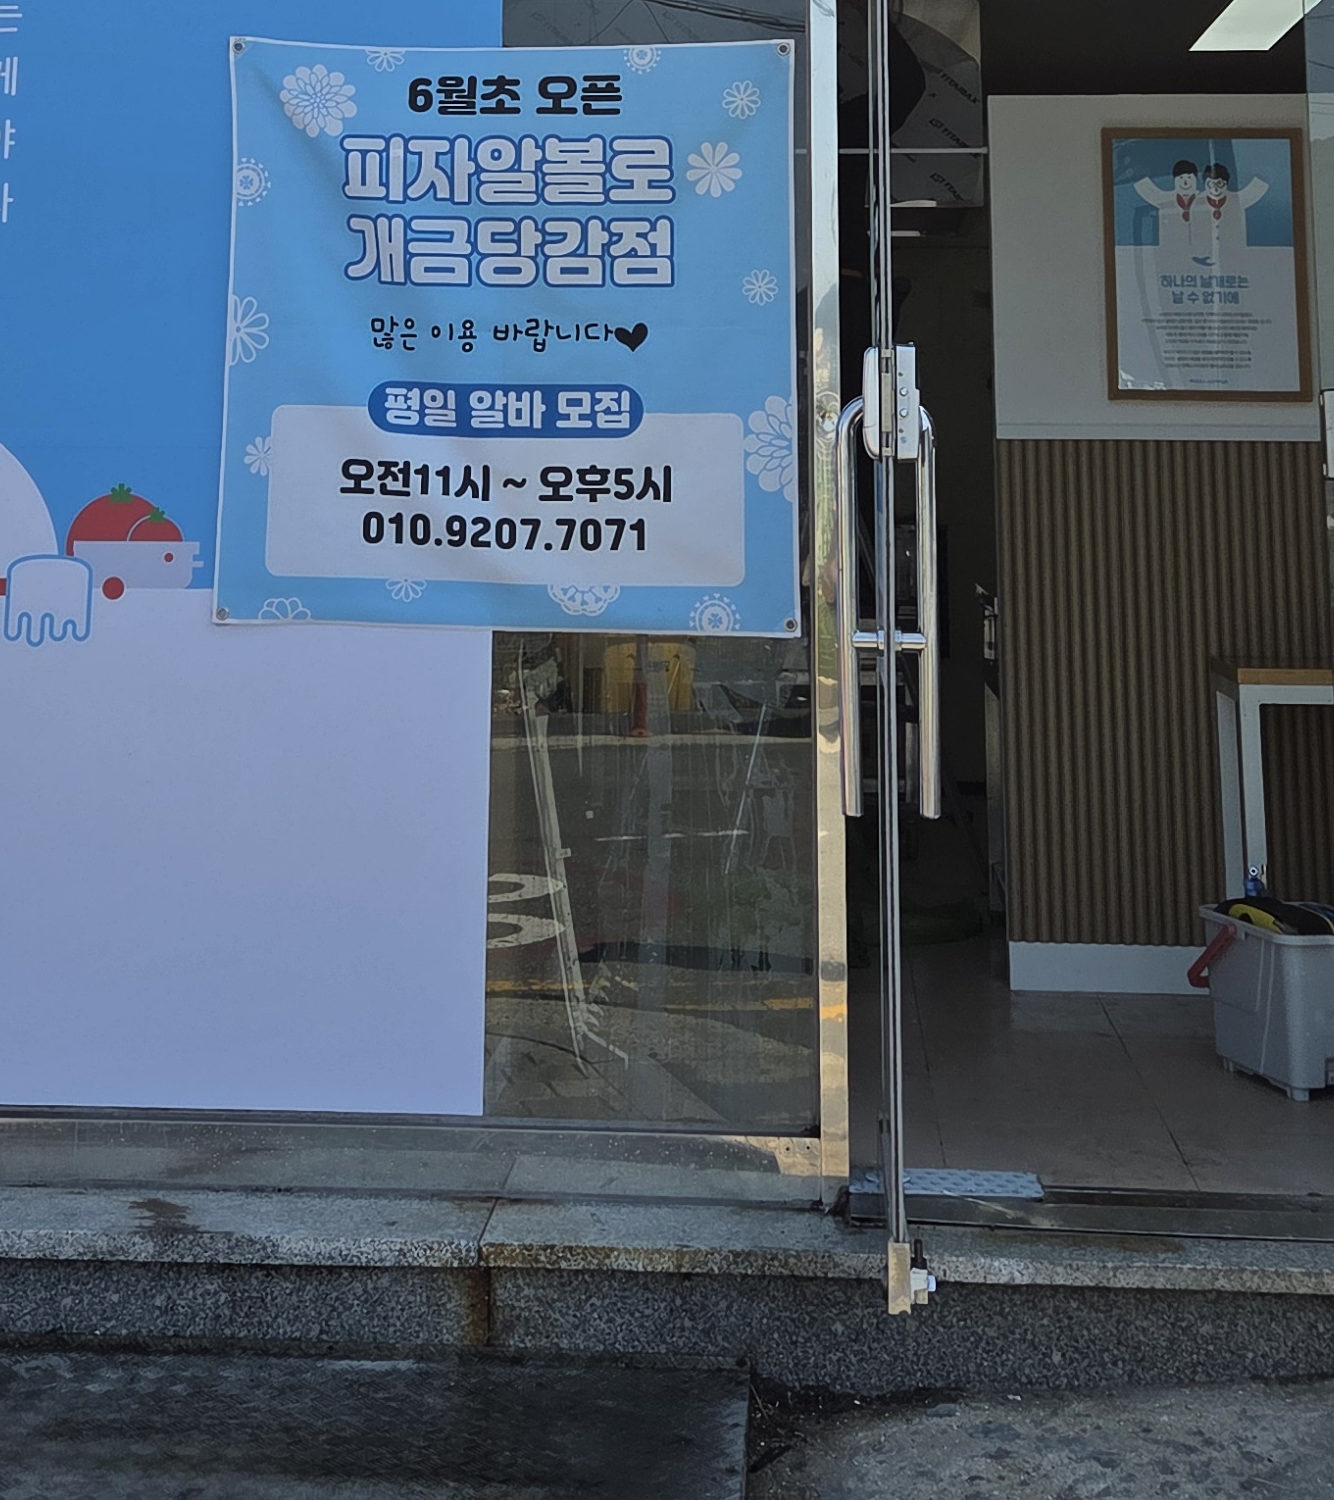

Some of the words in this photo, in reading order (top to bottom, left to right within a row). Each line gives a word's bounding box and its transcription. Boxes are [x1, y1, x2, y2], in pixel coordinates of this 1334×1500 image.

[407, 74, 522, 117] 6월초
[535, 73, 623, 117] 오픈
[340, 133, 676, 206] 피자알볼로
[343, 213, 675, 289] 개금당감점
[369, 315, 418, 351] 많은
[431, 319, 478, 353] 이용
[493, 317, 615, 353] 바랍니다
[384, 387, 458, 428] 평일
[470, 389, 546, 430] 알바
[555, 390, 631, 430] 모집
[339, 457, 492, 502] 오전11시
[537, 463, 673, 504] 오후5시
[362, 510, 647, 552] 010.9207.7071
